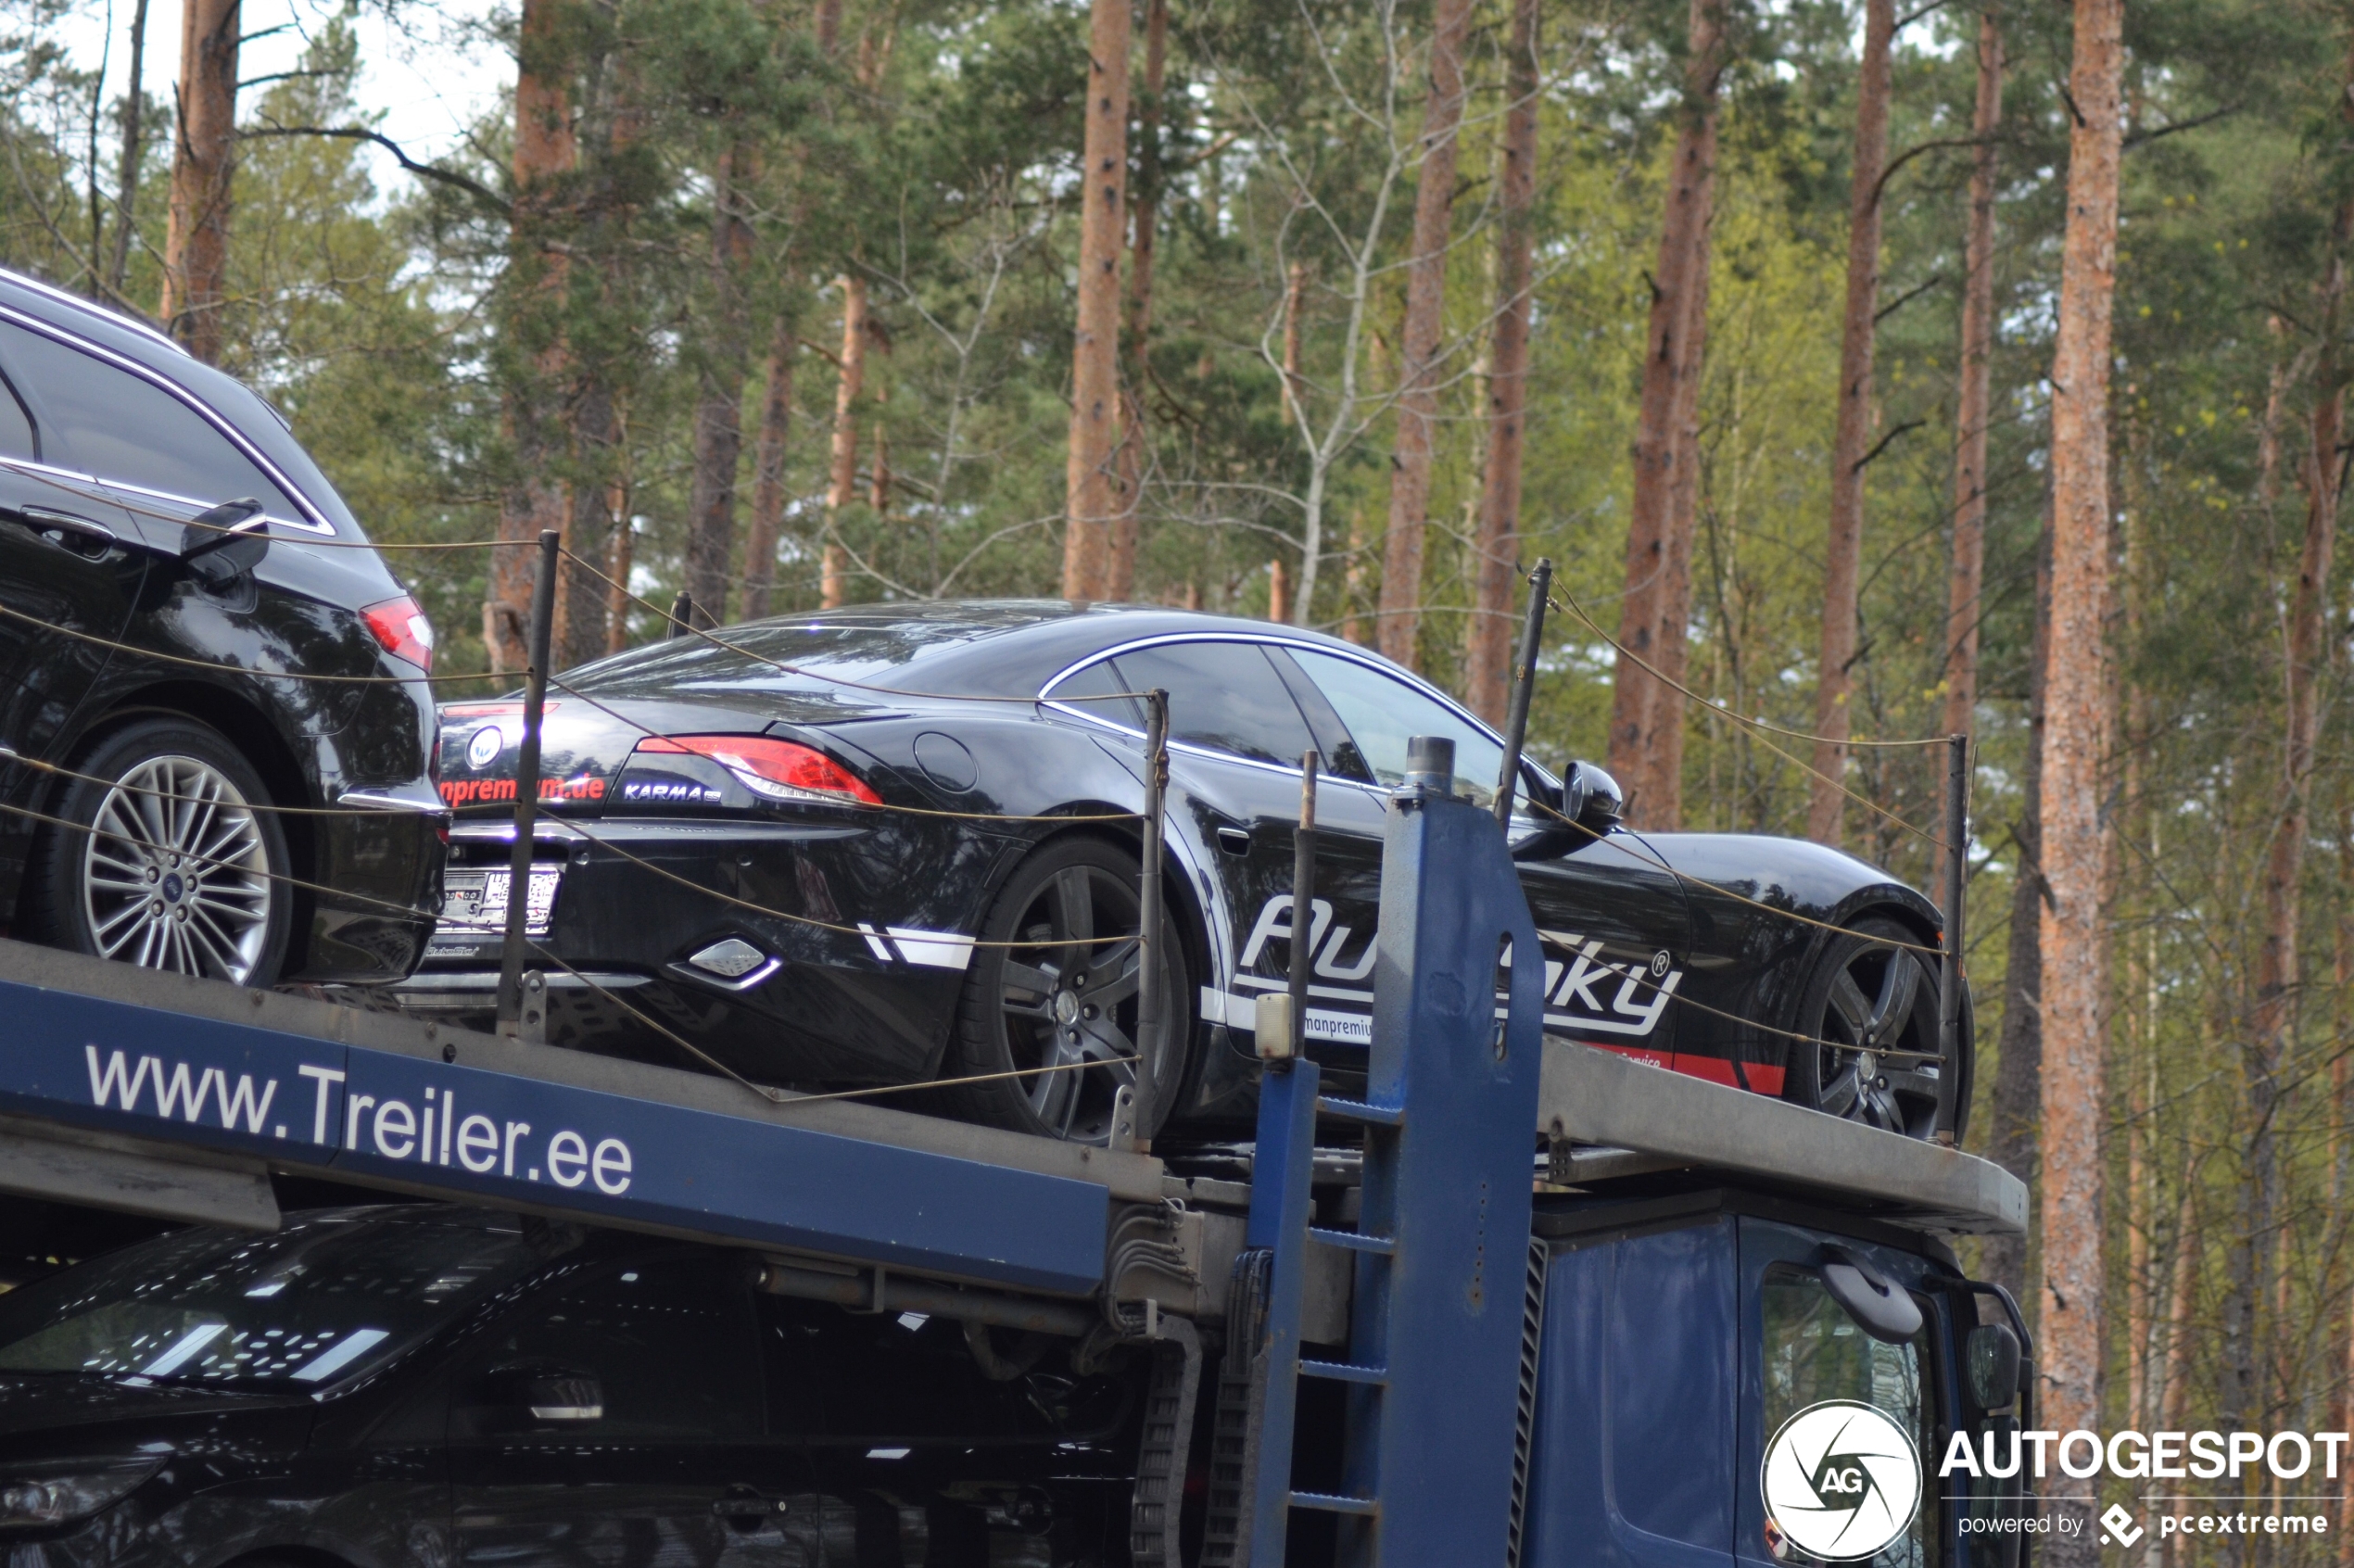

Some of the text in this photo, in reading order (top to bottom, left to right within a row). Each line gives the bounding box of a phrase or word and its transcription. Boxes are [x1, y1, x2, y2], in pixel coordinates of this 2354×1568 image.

[439, 772, 605, 809] npremm.de
[624, 784, 702, 802] KARMA
[85, 1044, 633, 1196] www.Treiler.ee
